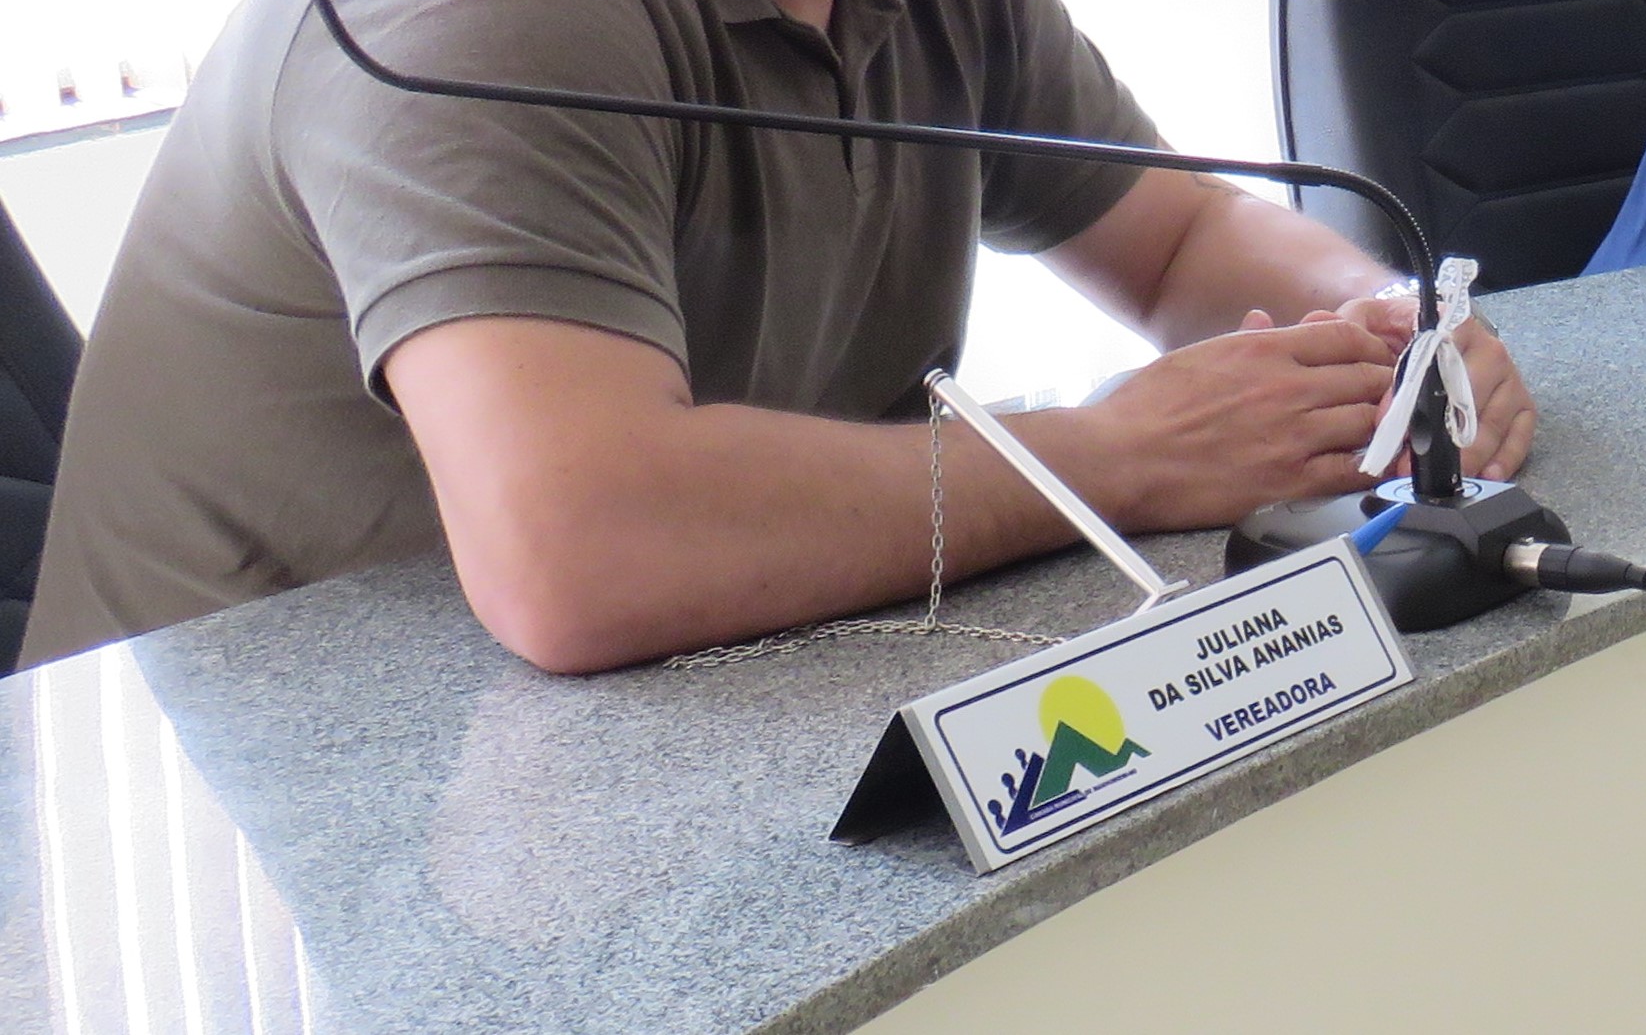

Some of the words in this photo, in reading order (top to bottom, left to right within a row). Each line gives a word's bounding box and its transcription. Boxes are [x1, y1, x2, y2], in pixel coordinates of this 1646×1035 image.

[1147, 682, 1185, 711] DA
[1184, 655, 1251, 695] SILVA
[1252, 614, 1344, 668] ANANIAS
[1196, 608, 1289, 661] JULIANA
[1204, 672, 1337, 741] VEREADORA
